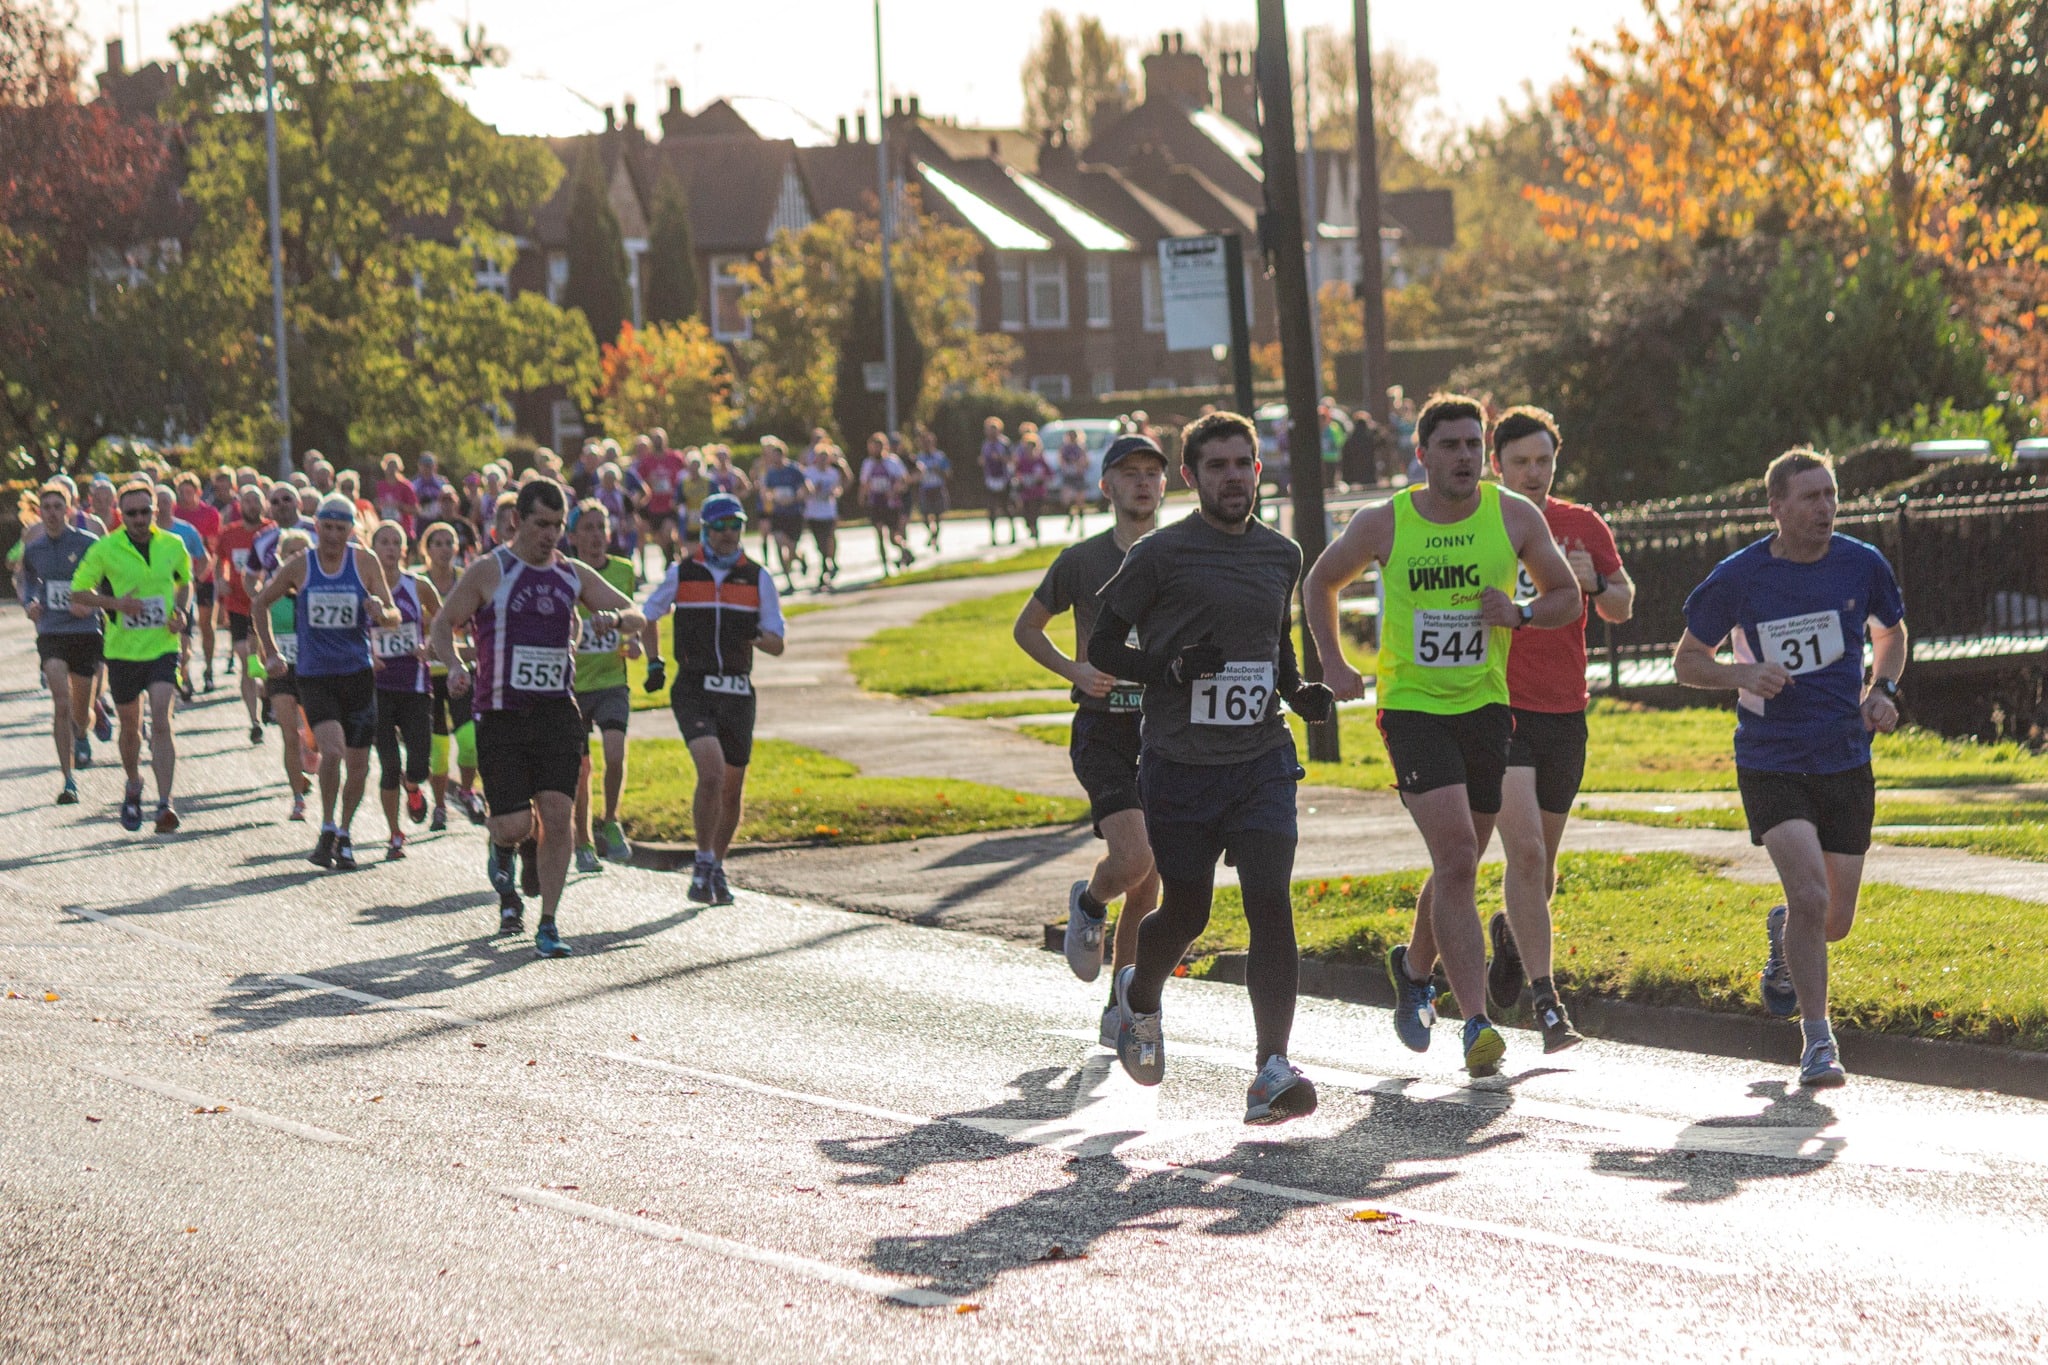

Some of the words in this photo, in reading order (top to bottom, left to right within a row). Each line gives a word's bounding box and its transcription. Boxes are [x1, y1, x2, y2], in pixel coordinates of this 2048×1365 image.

[1425, 534, 1475, 549] JONNY
[1407, 555, 1449, 568] GOOLE
[1408, 564, 1480, 592] VIKING
[312, 605, 354, 625] 278
[378, 634, 415, 654] 165
[1419, 629, 1484, 663] 544
[1781, 633, 1823, 671] 31
[518, 662, 563, 688] 553
[1226, 666, 1265, 674] MacDonald
[1201, 685, 1269, 721] 163
